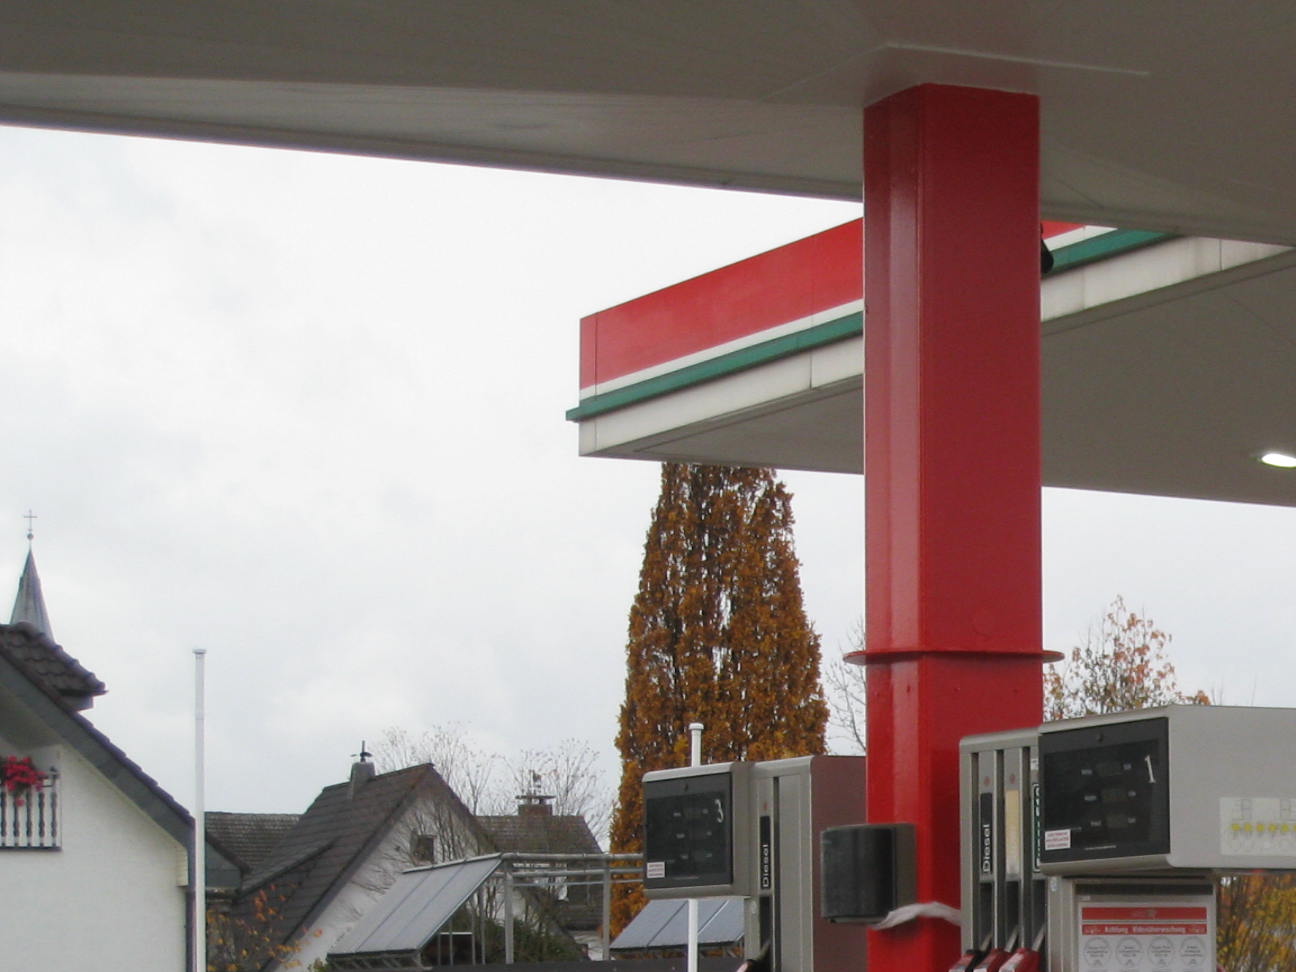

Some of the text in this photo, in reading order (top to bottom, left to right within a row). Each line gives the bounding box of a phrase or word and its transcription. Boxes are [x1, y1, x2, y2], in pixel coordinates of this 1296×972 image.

[1144, 755, 1156, 783] 1
[714, 799, 725, 823] 3
[983, 824, 991, 873] Diesel
